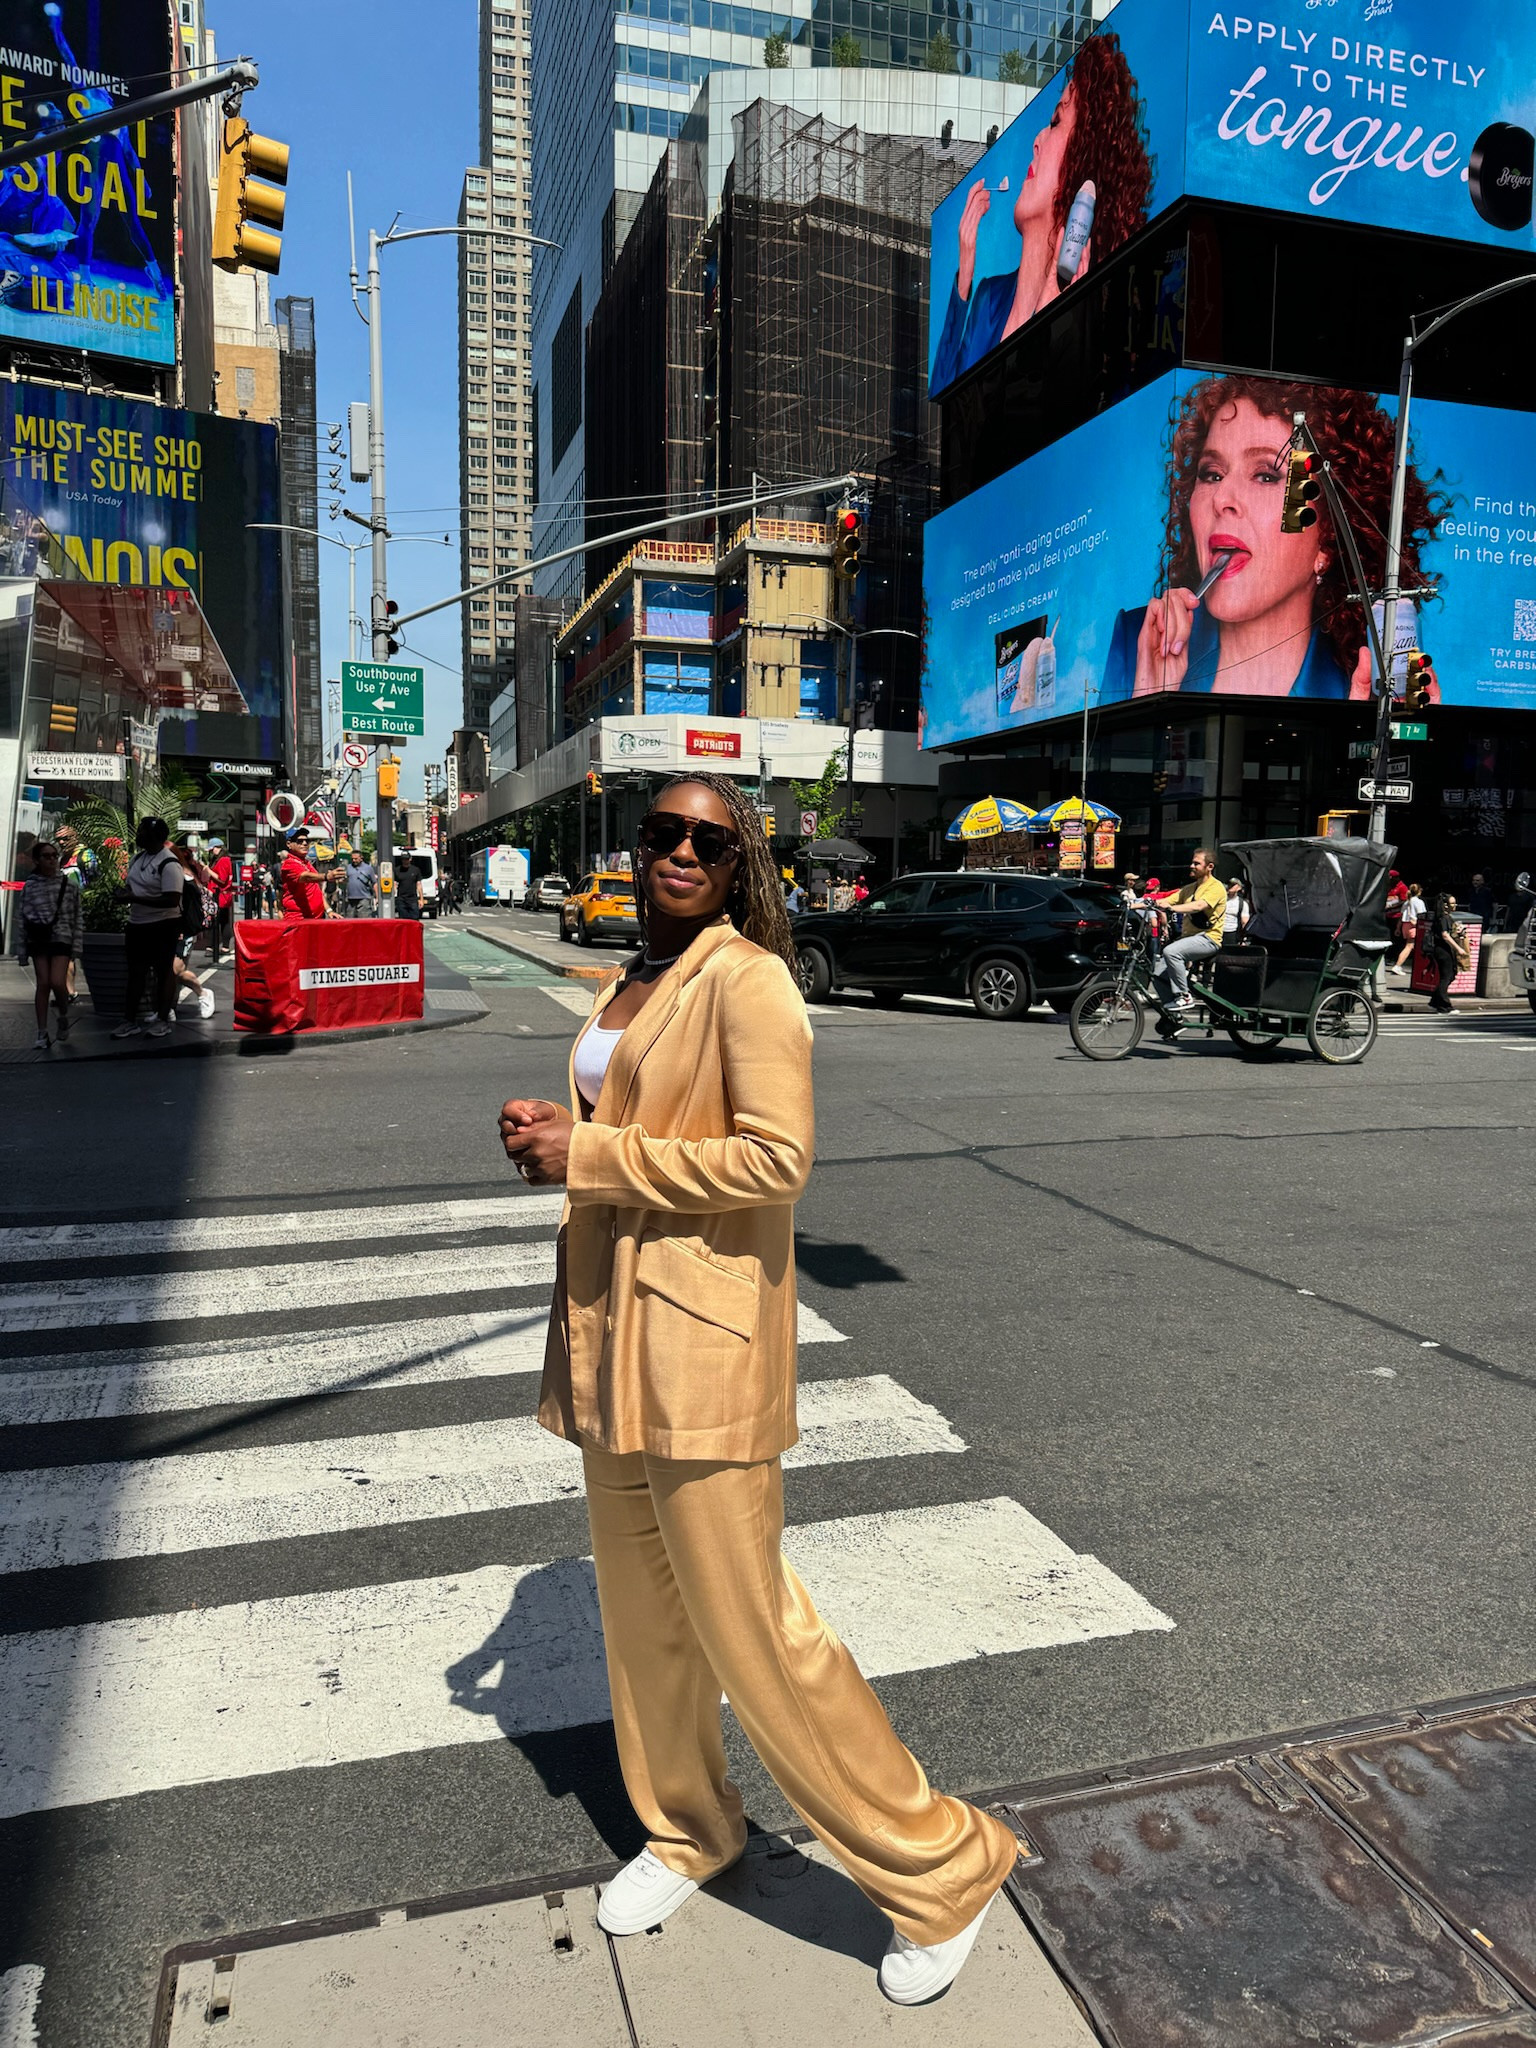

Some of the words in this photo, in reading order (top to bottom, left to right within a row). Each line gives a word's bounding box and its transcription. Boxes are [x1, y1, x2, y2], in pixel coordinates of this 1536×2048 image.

[1364, 4, 1393, 21] Smart
[1208, 12, 1317, 54] APPLY
[1331, 37, 1486, 88] DIRECTLY
[61, 62, 130, 97] NOMINEE
[1290, 64, 1332, 93] TO
[1345, 75, 1407, 109] THE
[1496, 167, 1532, 190] Breyers
[15, 413, 144, 462] MUST-SEE
[10, 446, 69, 484] THE
[90, 458, 204, 502] SUMME
[66, 490, 89, 502] USA
[92, 493, 123, 508] Today
[1474, 496, 1513, 516] Find
[1440, 519, 1500, 543] feeling
[1454, 544, 1470, 561] in
[1476, 548, 1504, 565] the
[951, 584, 986, 611] designed
[987, 582, 996, 594] to
[998, 571, 1022, 589] make
[1024, 562, 1041, 581] you
[1043, 550, 1061, 568] feel
[1063, 529, 1109, 563] younger.
[963, 569, 979, 584] The
[980, 559, 998, 577] only
[988, 601, 1025, 625] DELICIOUS
[1027, 587, 1059, 609] CREAMY
[1490, 647, 1511, 657] TRY
[349, 665, 417, 682] Southbound
[356, 680, 375, 693] Use
[379, 682, 385, 694] 7
[390, 683, 410, 696] Ave
[352, 716, 377, 730] Best
[382, 718, 415, 732] Route
[1406, 725, 1411, 737] 7
[638, 739, 661, 747] OPEN
[31, 756, 74, 765] PEDESTRIAN
[75, 757, 93, 766] FLOW
[95, 758, 113, 767] ZONE
[857, 751, 878, 759] OPEN
[69, 767, 85, 775] KEEP
[88, 768, 114, 776] MOVING
[1391, 787, 1407, 795] WAY
[963, 824, 999, 837] SABRETT
[311, 969, 355, 984] TIMES
[358, 966, 410, 982] SQUARE
